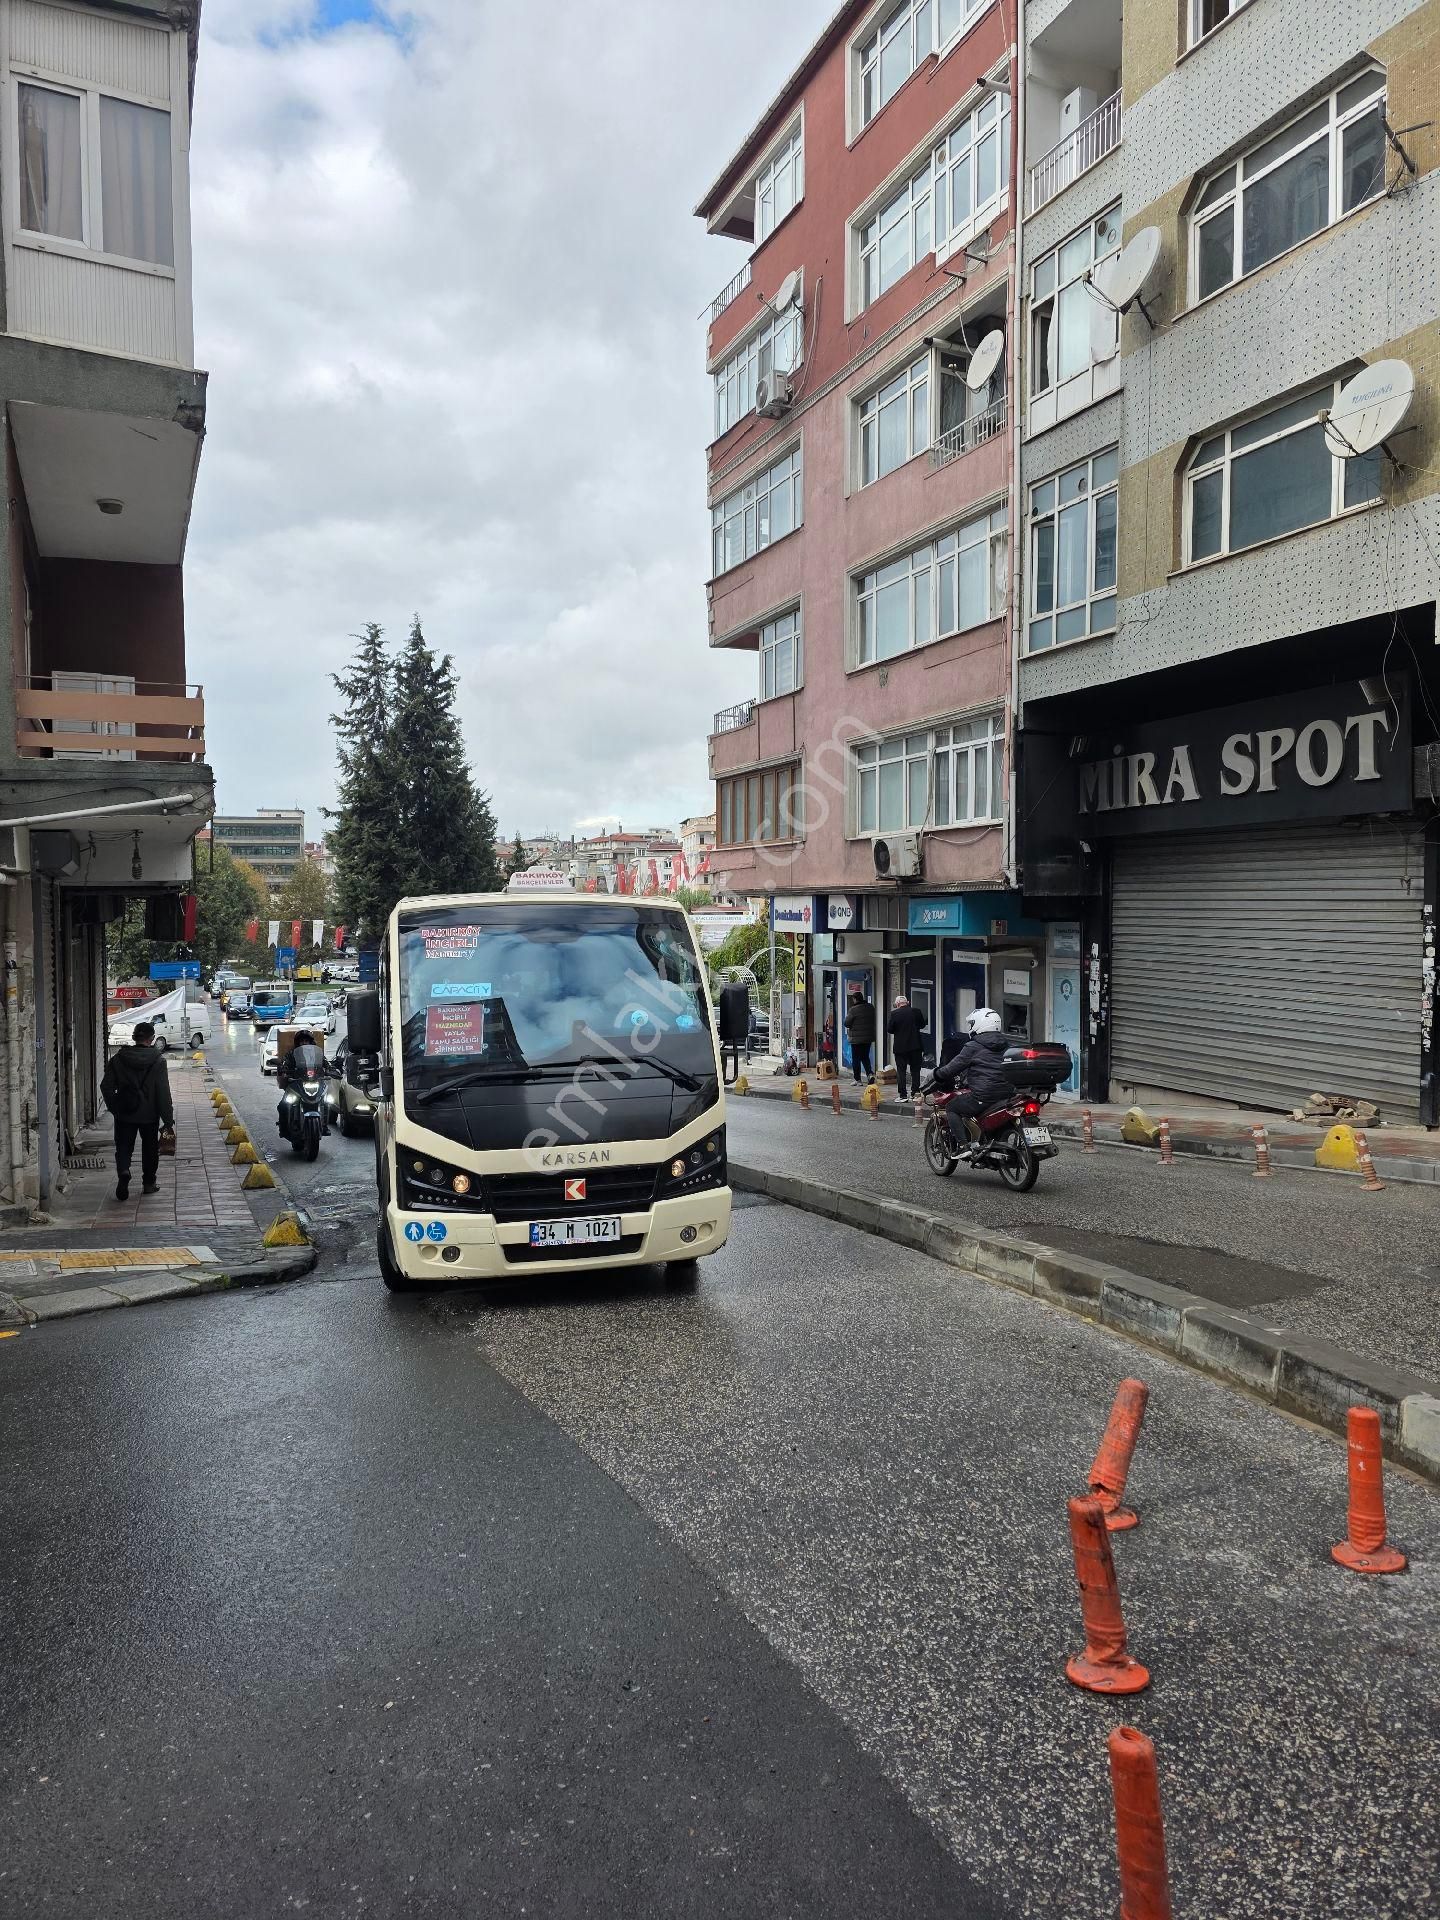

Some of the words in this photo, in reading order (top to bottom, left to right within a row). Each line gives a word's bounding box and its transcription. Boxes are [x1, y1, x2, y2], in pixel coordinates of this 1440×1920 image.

[1078, 744, 1201, 814] MİRA
[1220, 710, 1389, 795] SPOT
[837, 907, 851, 917] QNB
[931, 909, 947, 919] TAM
[421, 926, 481, 938] BAKIRKÖY
[542, 1150, 610, 1166] KARSAN
[540, 1225, 555, 1240] 34
[566, 1224, 574, 1238] M
[586, 1221, 616, 1237] 1021
